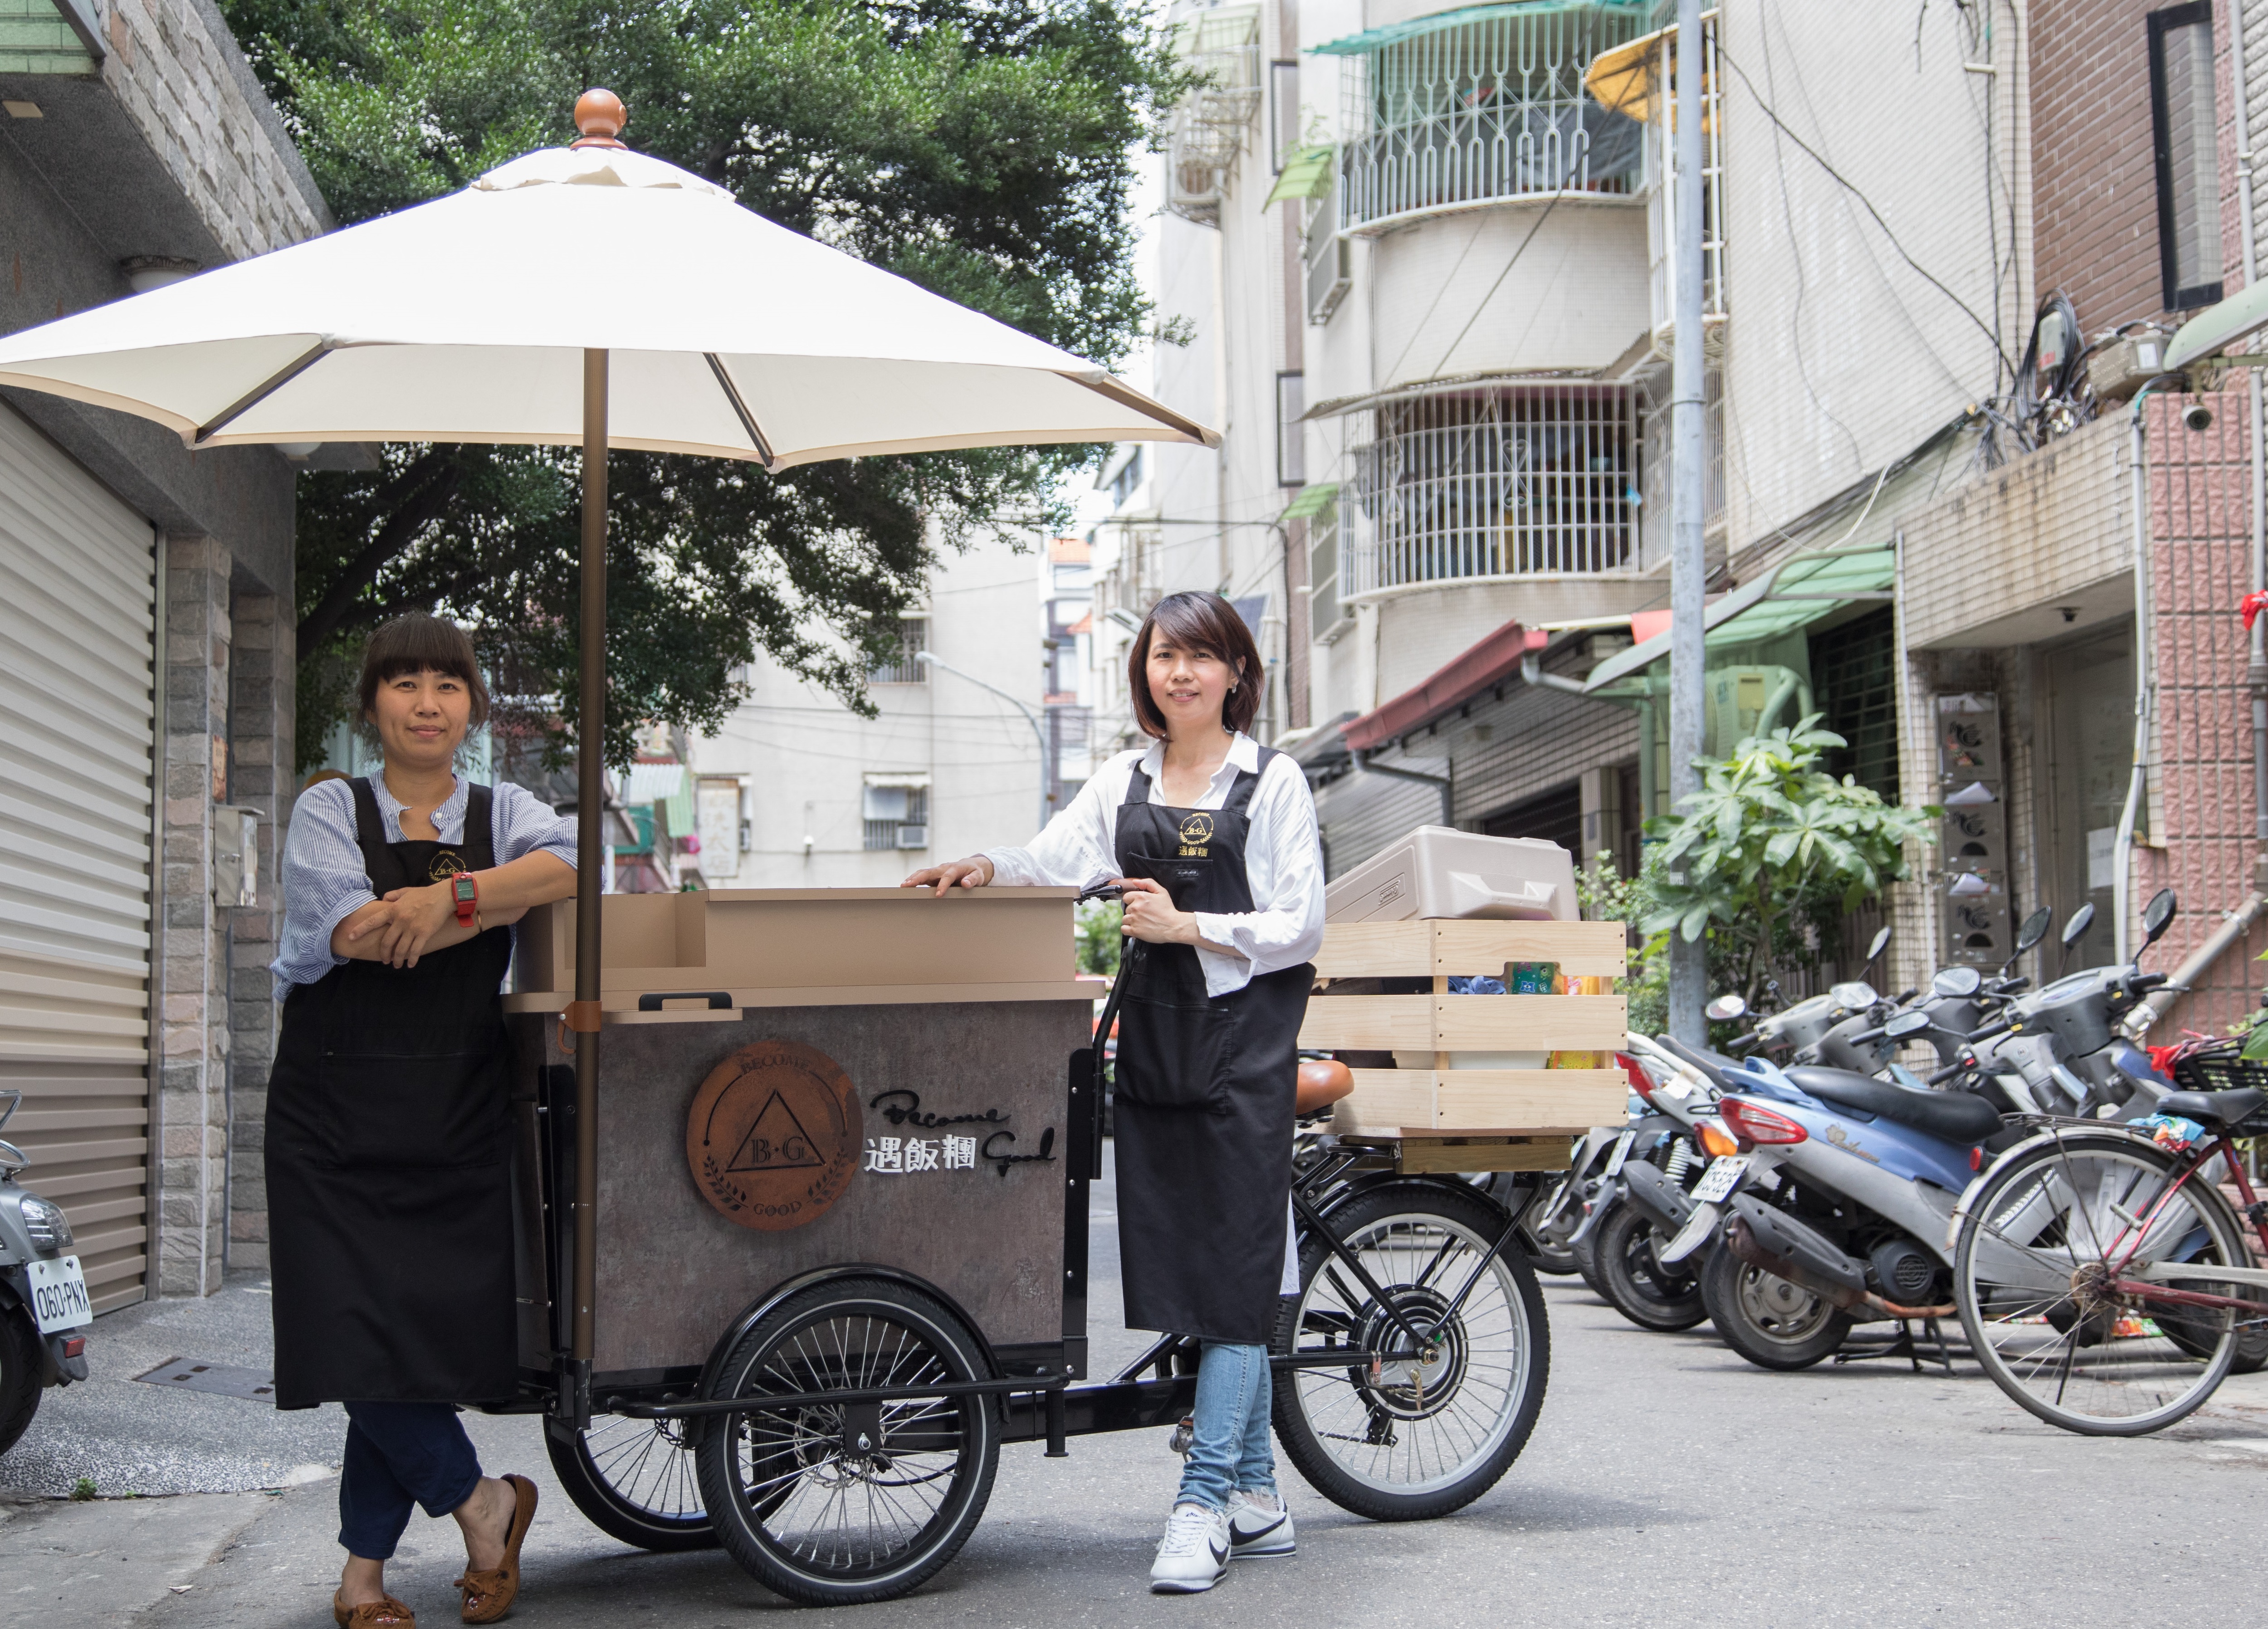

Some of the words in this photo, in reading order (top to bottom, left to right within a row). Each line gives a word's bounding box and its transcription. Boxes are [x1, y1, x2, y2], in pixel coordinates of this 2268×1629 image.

[740, 1054, 811, 1075] BECOME
[870, 1089, 1012, 1128] Become
[863, 1134, 977, 1173] 遇飯糰
[982, 1127, 1056, 1177] Good
[753, 1201, 802, 1217] GOOD
